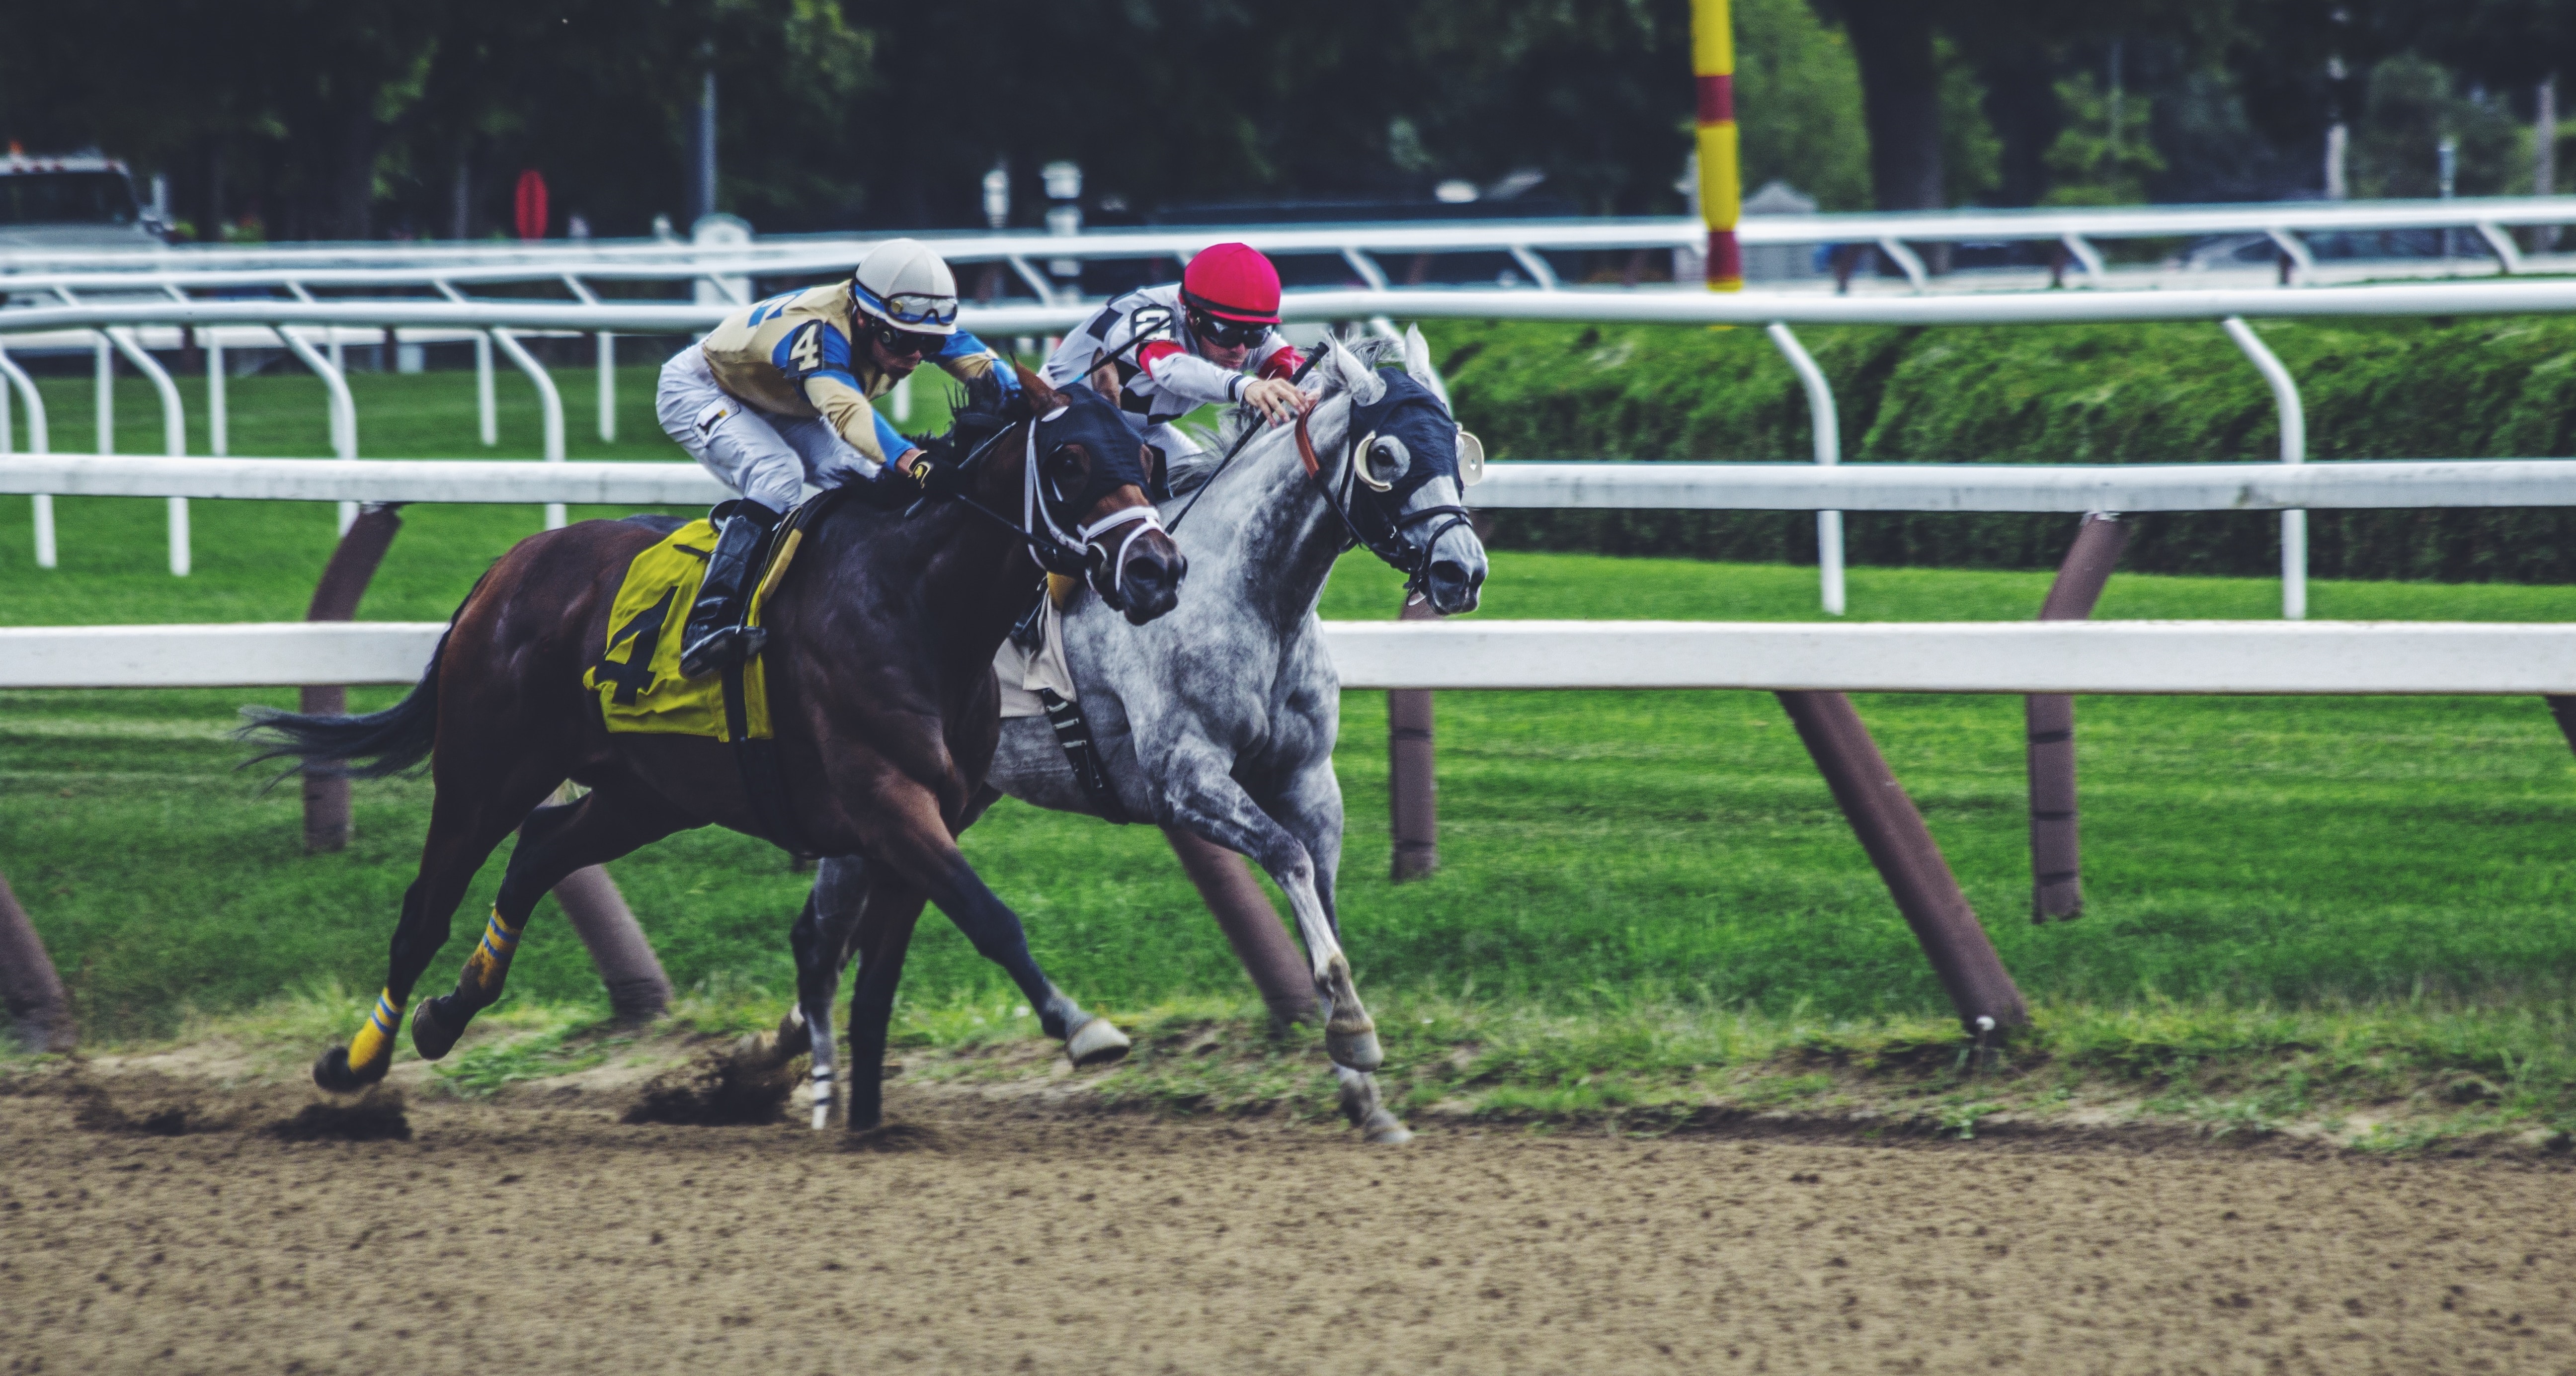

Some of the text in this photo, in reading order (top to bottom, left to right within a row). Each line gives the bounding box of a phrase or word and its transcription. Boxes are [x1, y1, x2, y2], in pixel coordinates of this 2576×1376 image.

[790, 324, 818, 371] 4
[1135, 310, 1171, 340] 2
[594, 586, 679, 706] 4
